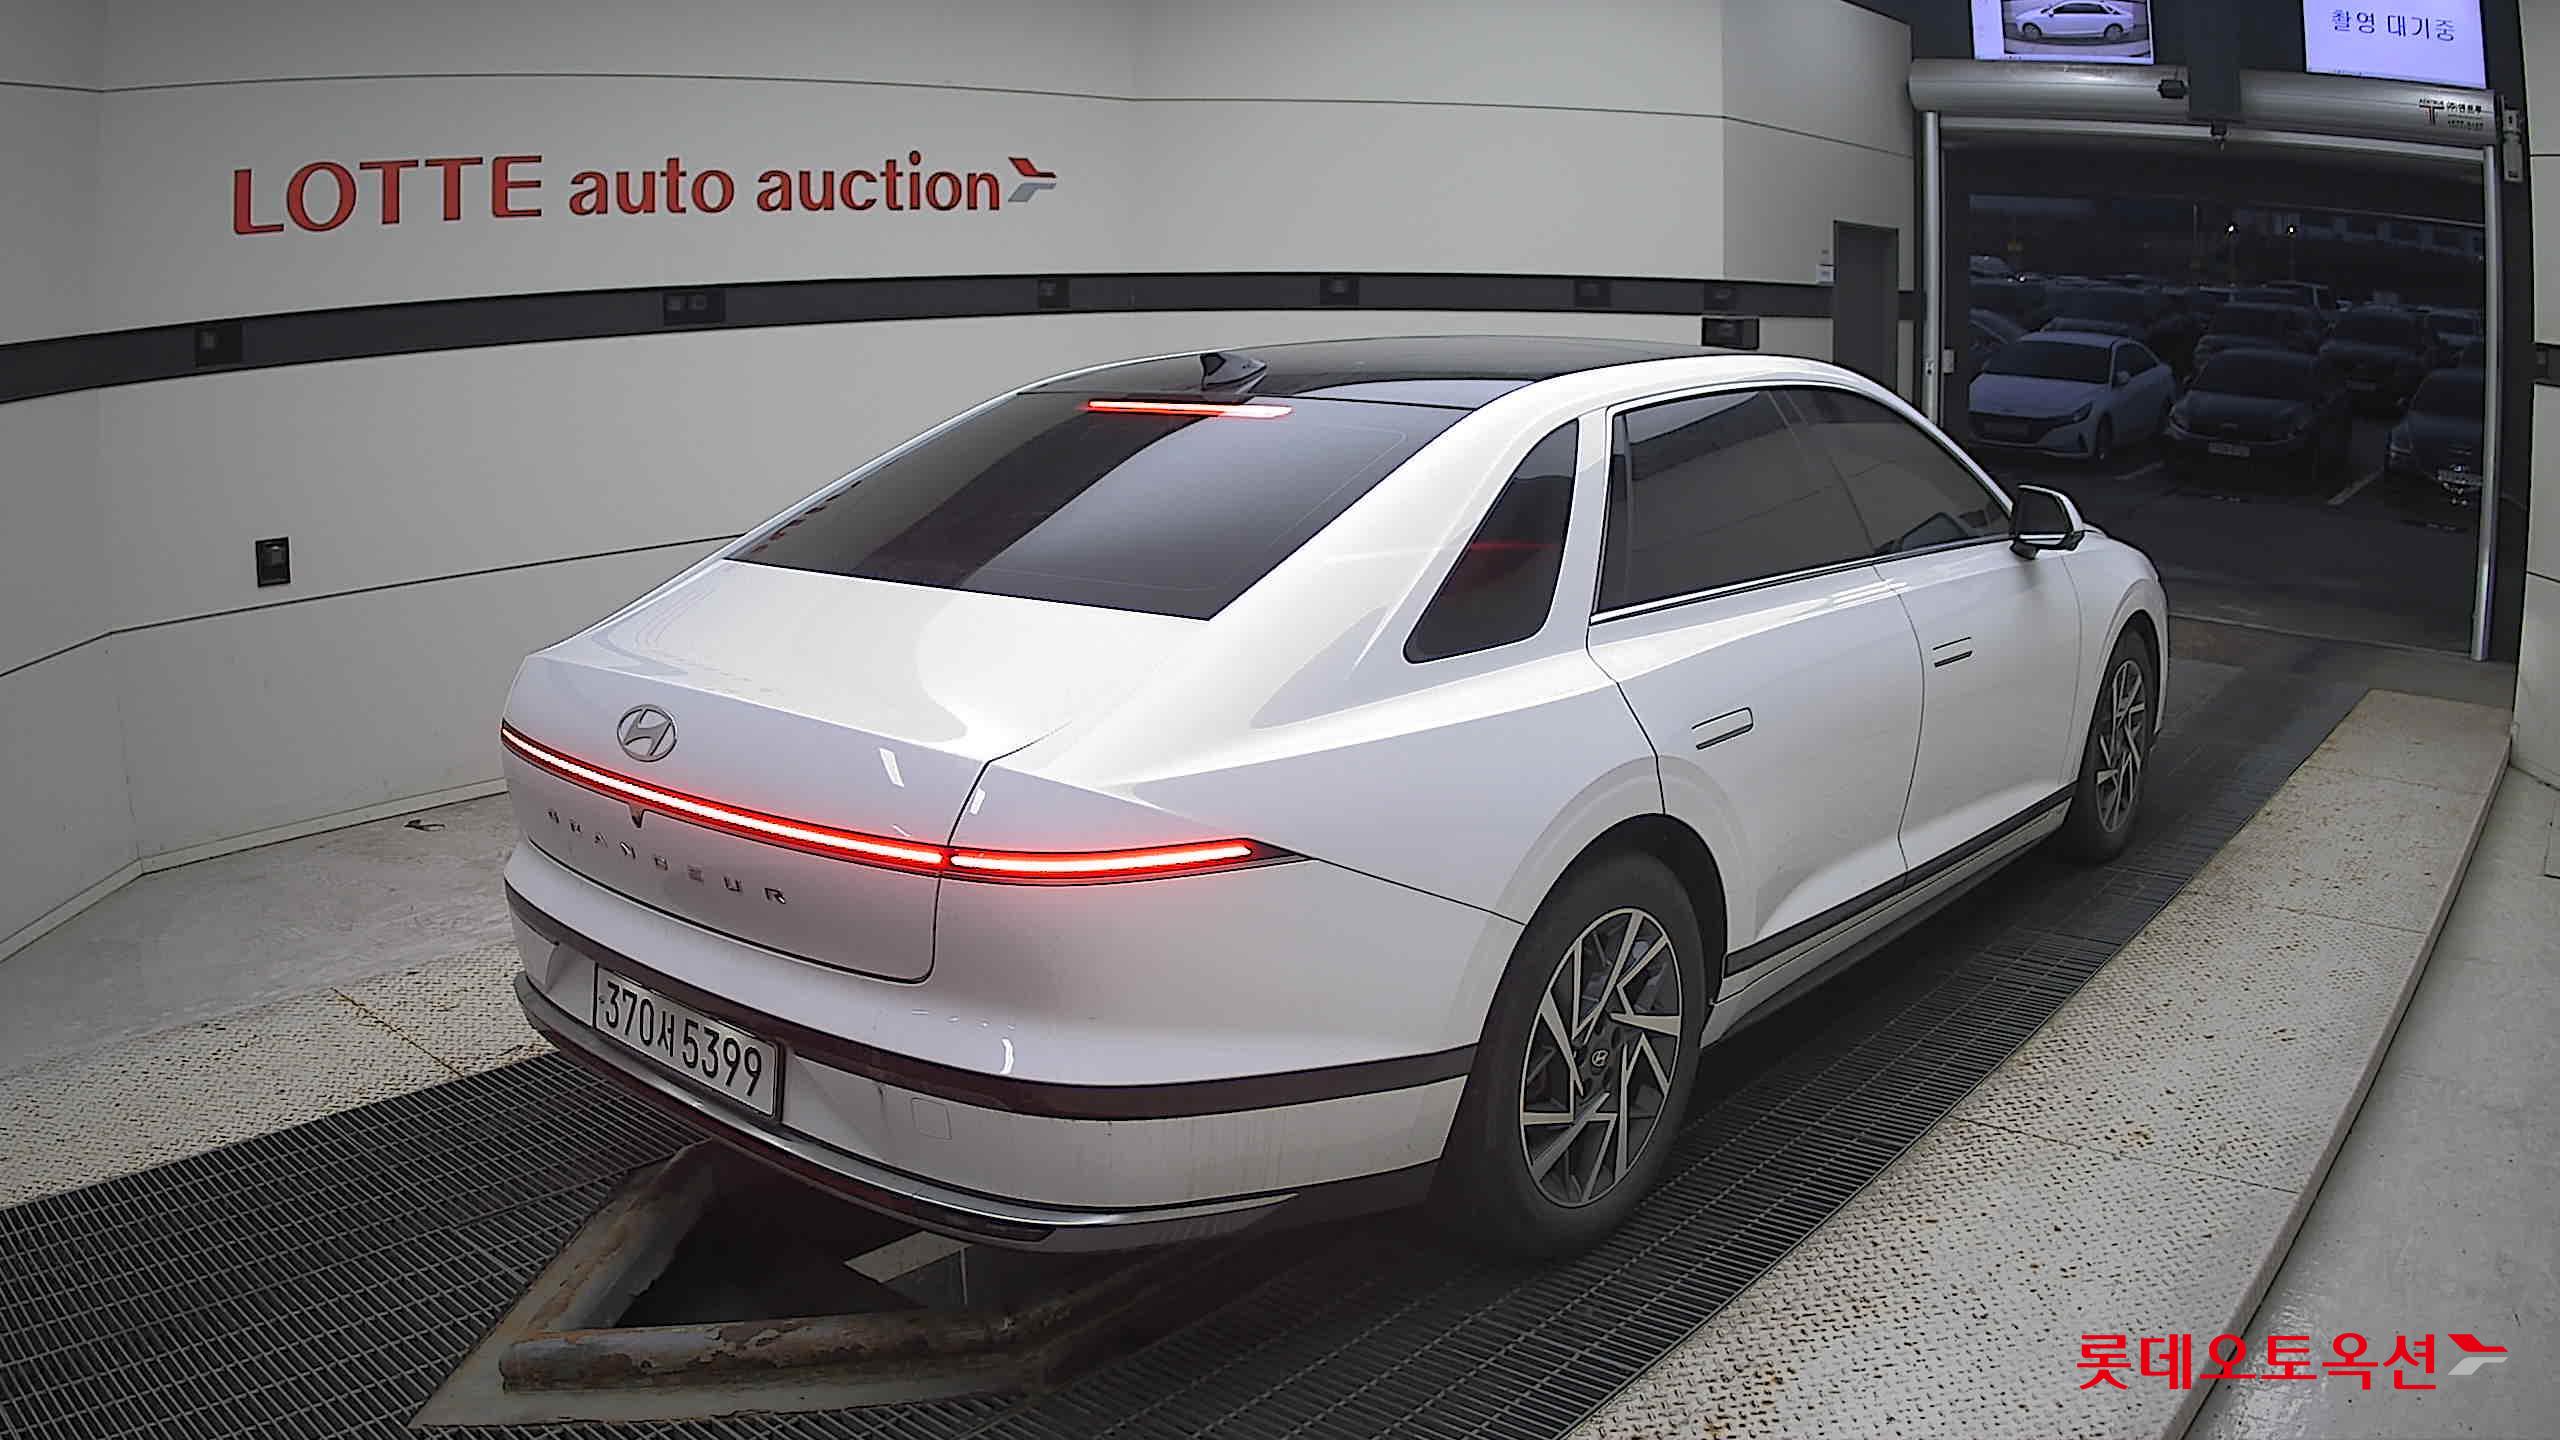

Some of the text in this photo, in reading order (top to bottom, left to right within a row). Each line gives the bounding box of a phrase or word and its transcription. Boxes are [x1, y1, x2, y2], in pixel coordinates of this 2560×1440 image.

[233, 150, 1000, 234] LOTTE auto auction
